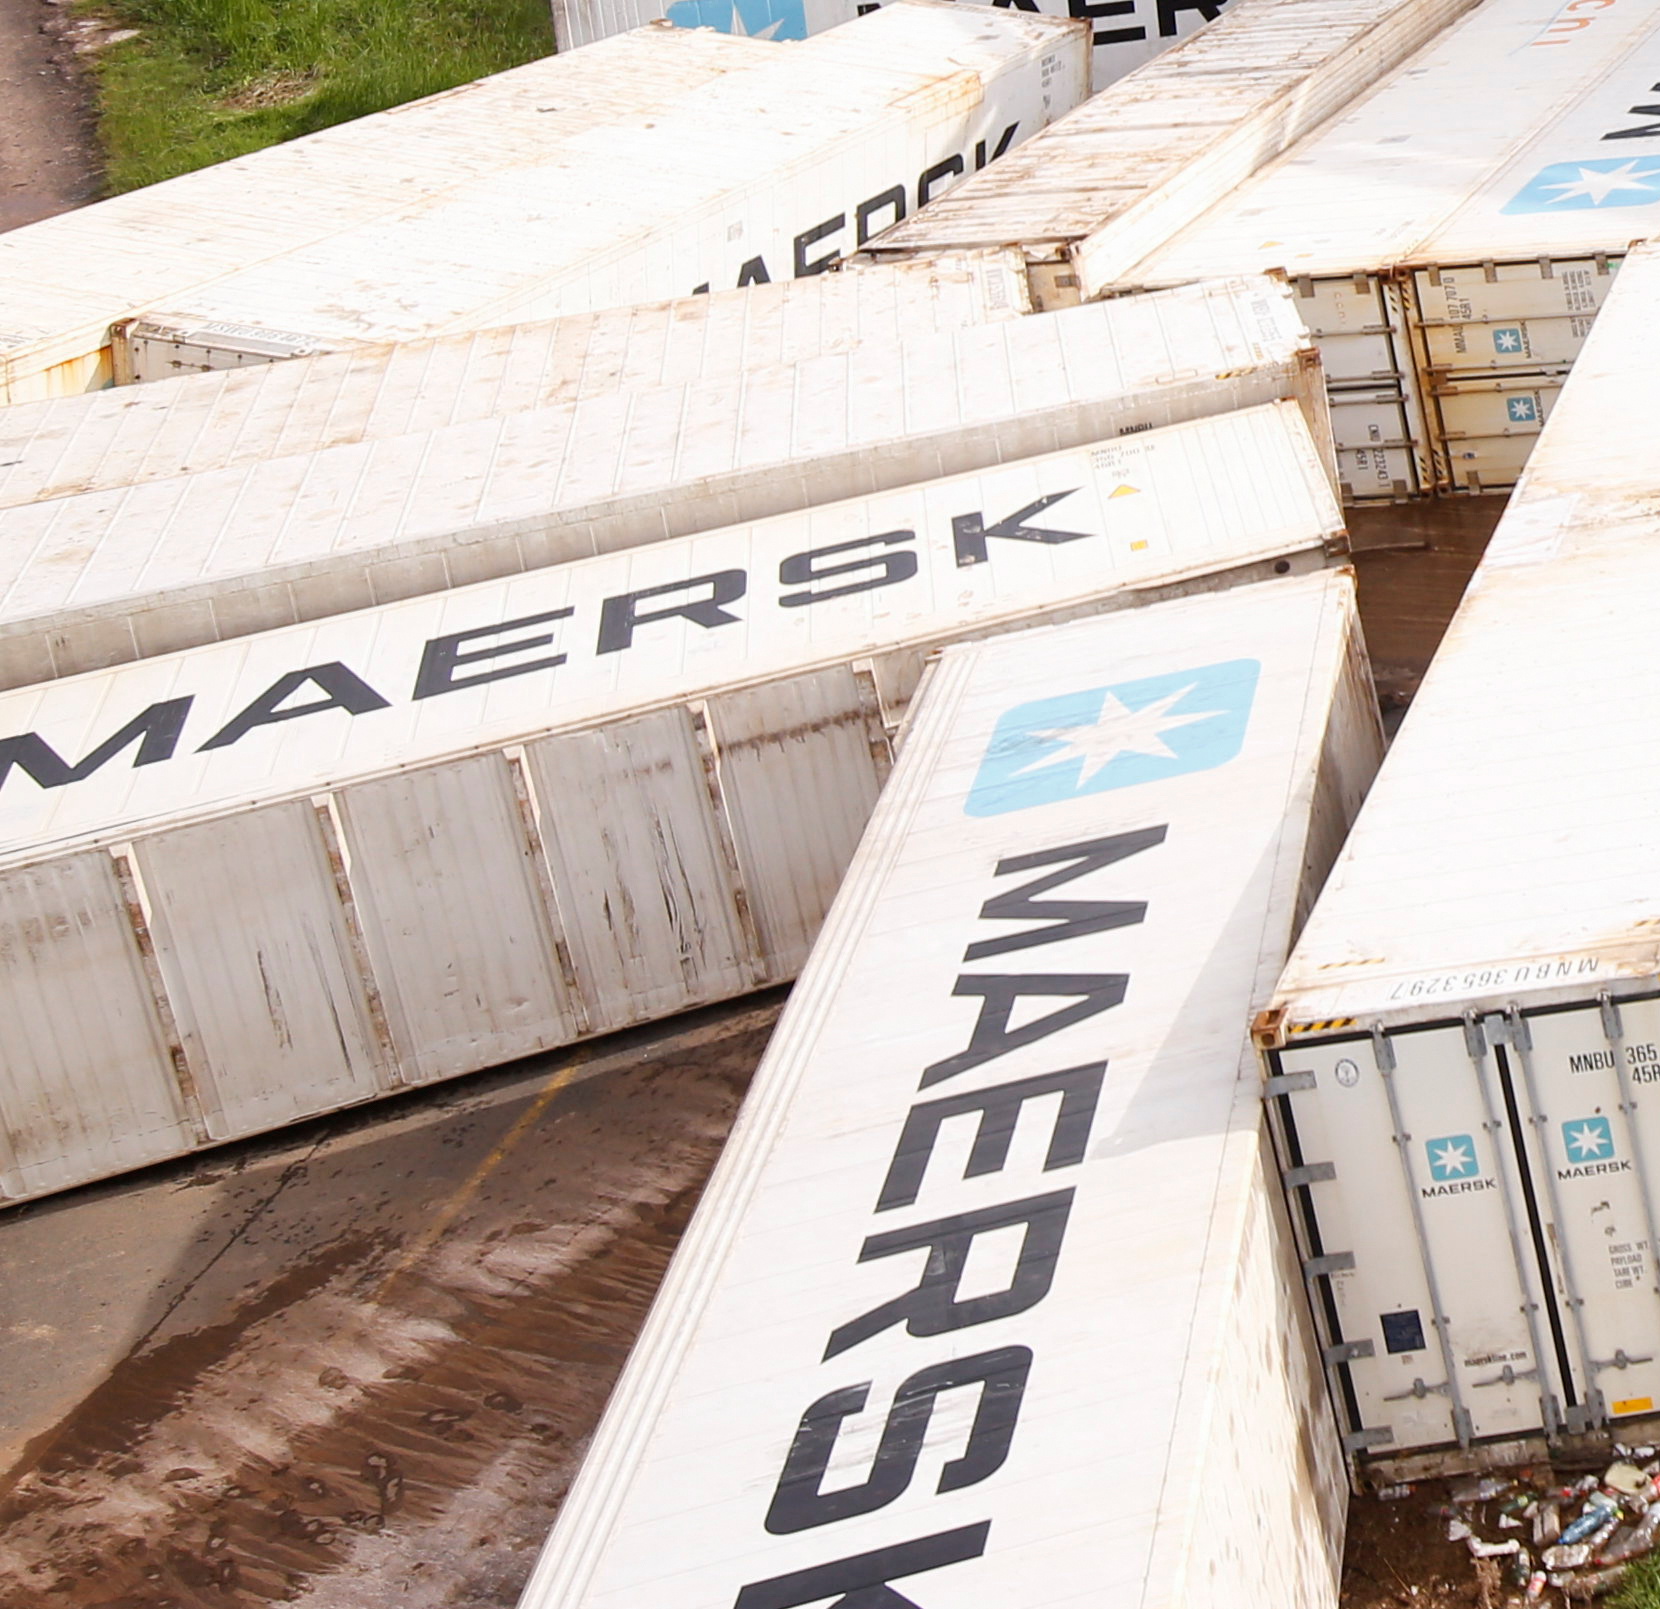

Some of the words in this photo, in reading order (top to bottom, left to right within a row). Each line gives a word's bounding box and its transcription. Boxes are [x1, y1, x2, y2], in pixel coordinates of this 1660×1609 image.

[692, 121, 1020, 295] ERSK
[1444, 285, 1457, 303] 707
[1447, 304, 1460, 320] 107
[1459, 298, 1473, 321] 45R1
[1451, 323, 1467, 354] MMAU
[1520, 321, 1532, 359] MAERSK
[1356, 451, 1369, 471] 45R1
[1373, 447, 1389, 481] 223243
[0, 487, 1097, 791] MAERSK
[1512, 957, 1600, 984] MNBU
[1568, 1050, 1616, 1075] MNBU
[1626, 1042, 1658, 1066] 365
[1557, 1160, 1634, 1182] MAERSK
[1421, 1178, 1498, 1199] MAERSK
[1608, 1243, 1632, 1254] GROSS
[1611, 1254, 1642, 1266] PAYLOAD
[1613, 1267, 1630, 1278] TARE
[1615, 1279, 1634, 1290] CUBE
